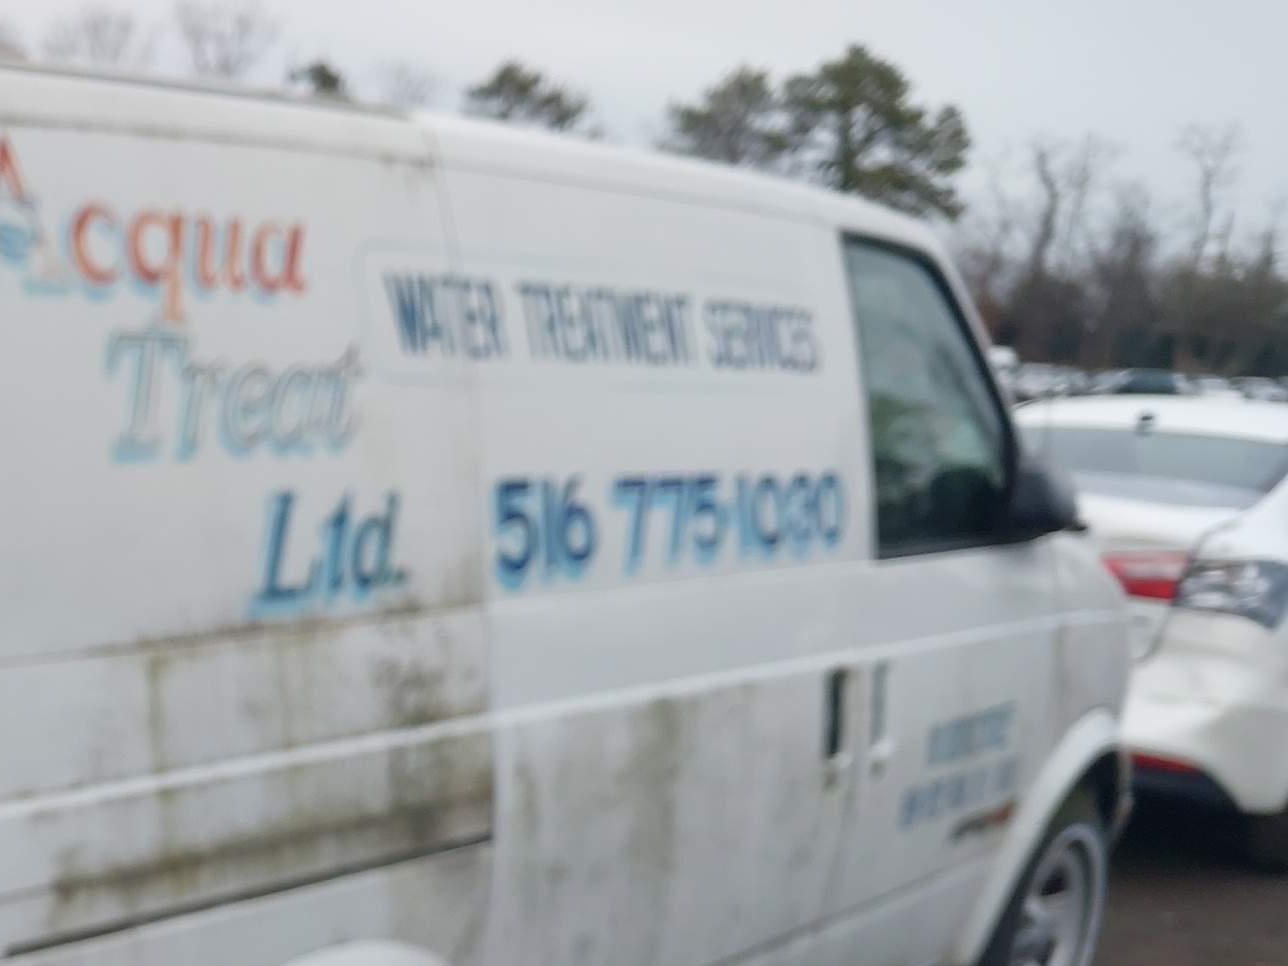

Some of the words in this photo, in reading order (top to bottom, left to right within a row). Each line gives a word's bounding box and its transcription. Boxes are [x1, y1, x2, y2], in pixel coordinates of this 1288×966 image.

[384, 272, 507, 360] WATER
[516, 278, 694, 366] TREATMENT
[107, 327, 362, 463] Treat
[246, 488, 410, 617] Ltd.
[493, 474, 597, 590] 516
